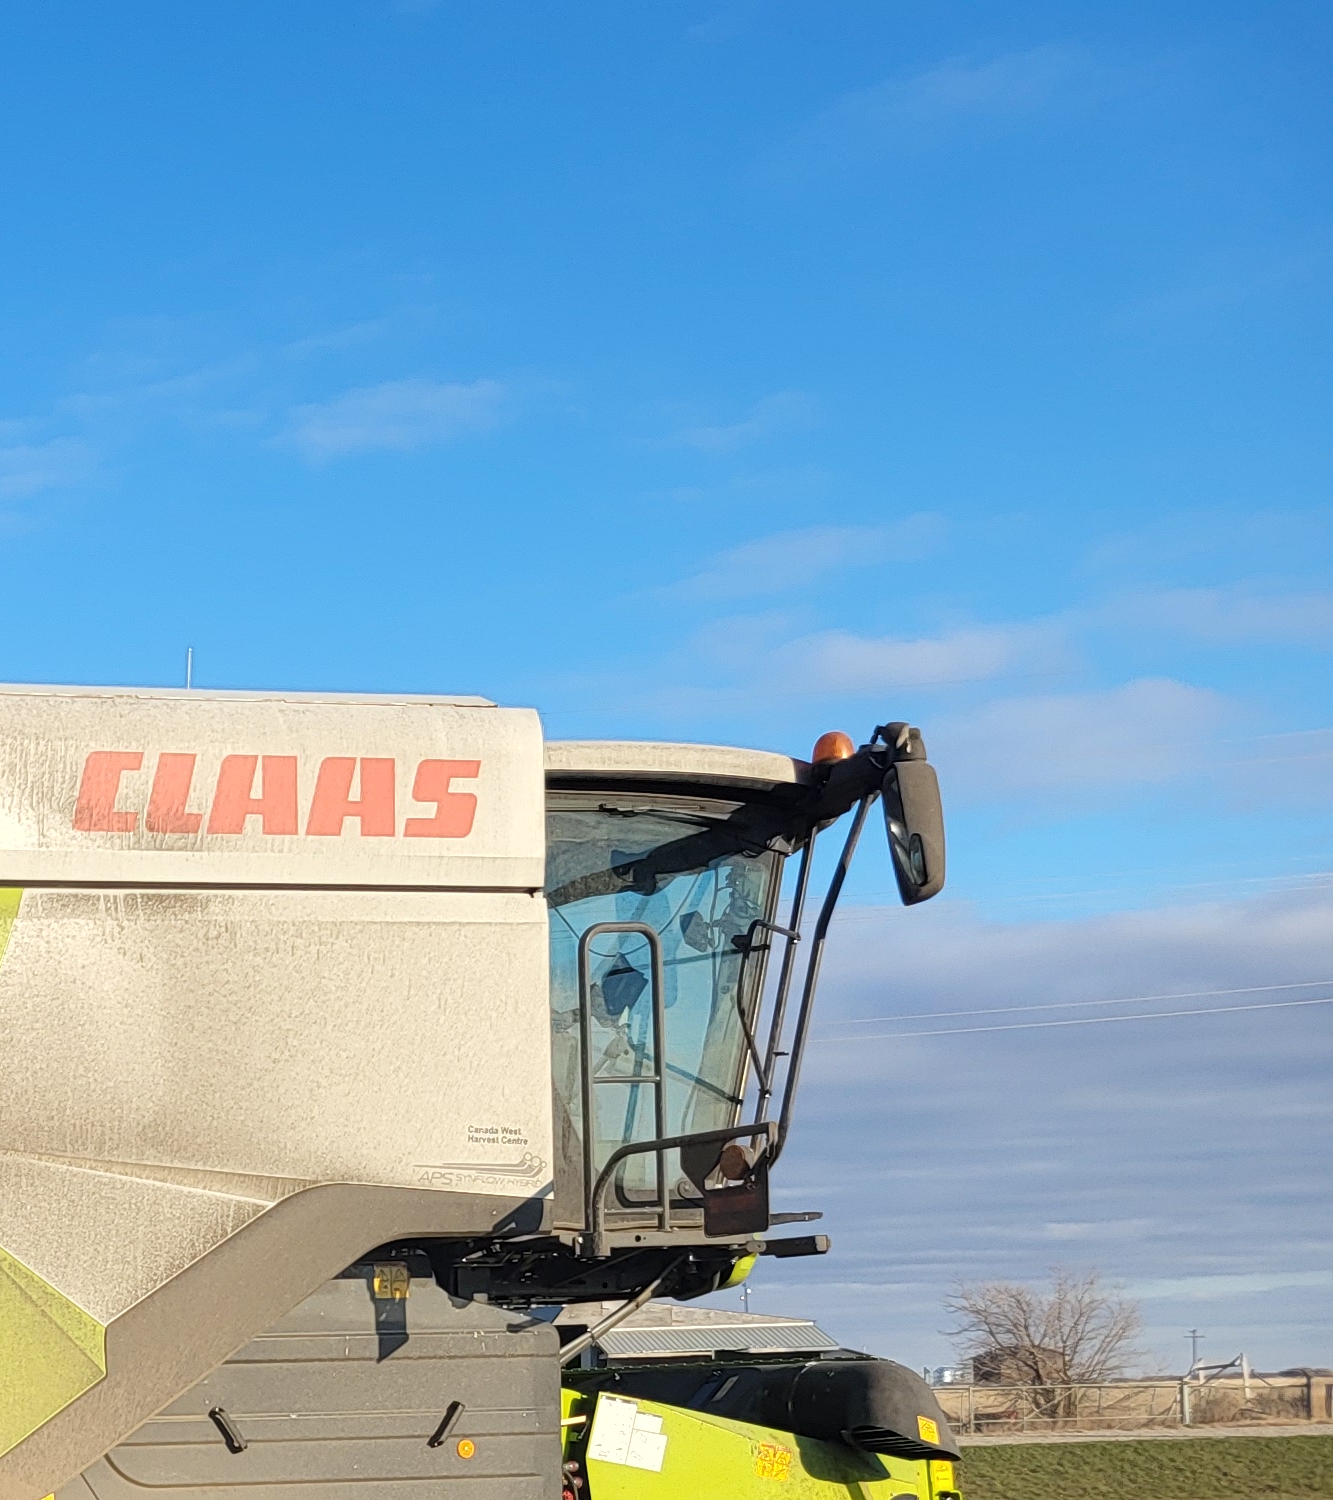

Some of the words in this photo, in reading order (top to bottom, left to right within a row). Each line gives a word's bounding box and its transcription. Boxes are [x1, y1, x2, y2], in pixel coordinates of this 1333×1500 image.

[73, 750, 482, 838] CLAAS
[468, 1125, 499, 1135] Canada
[501, 1126, 522, 1135] West
[468, 1134, 500, 1144] Harvest
[501, 1136, 528, 1145] Centre
[418, 1171, 454, 1185] APS
